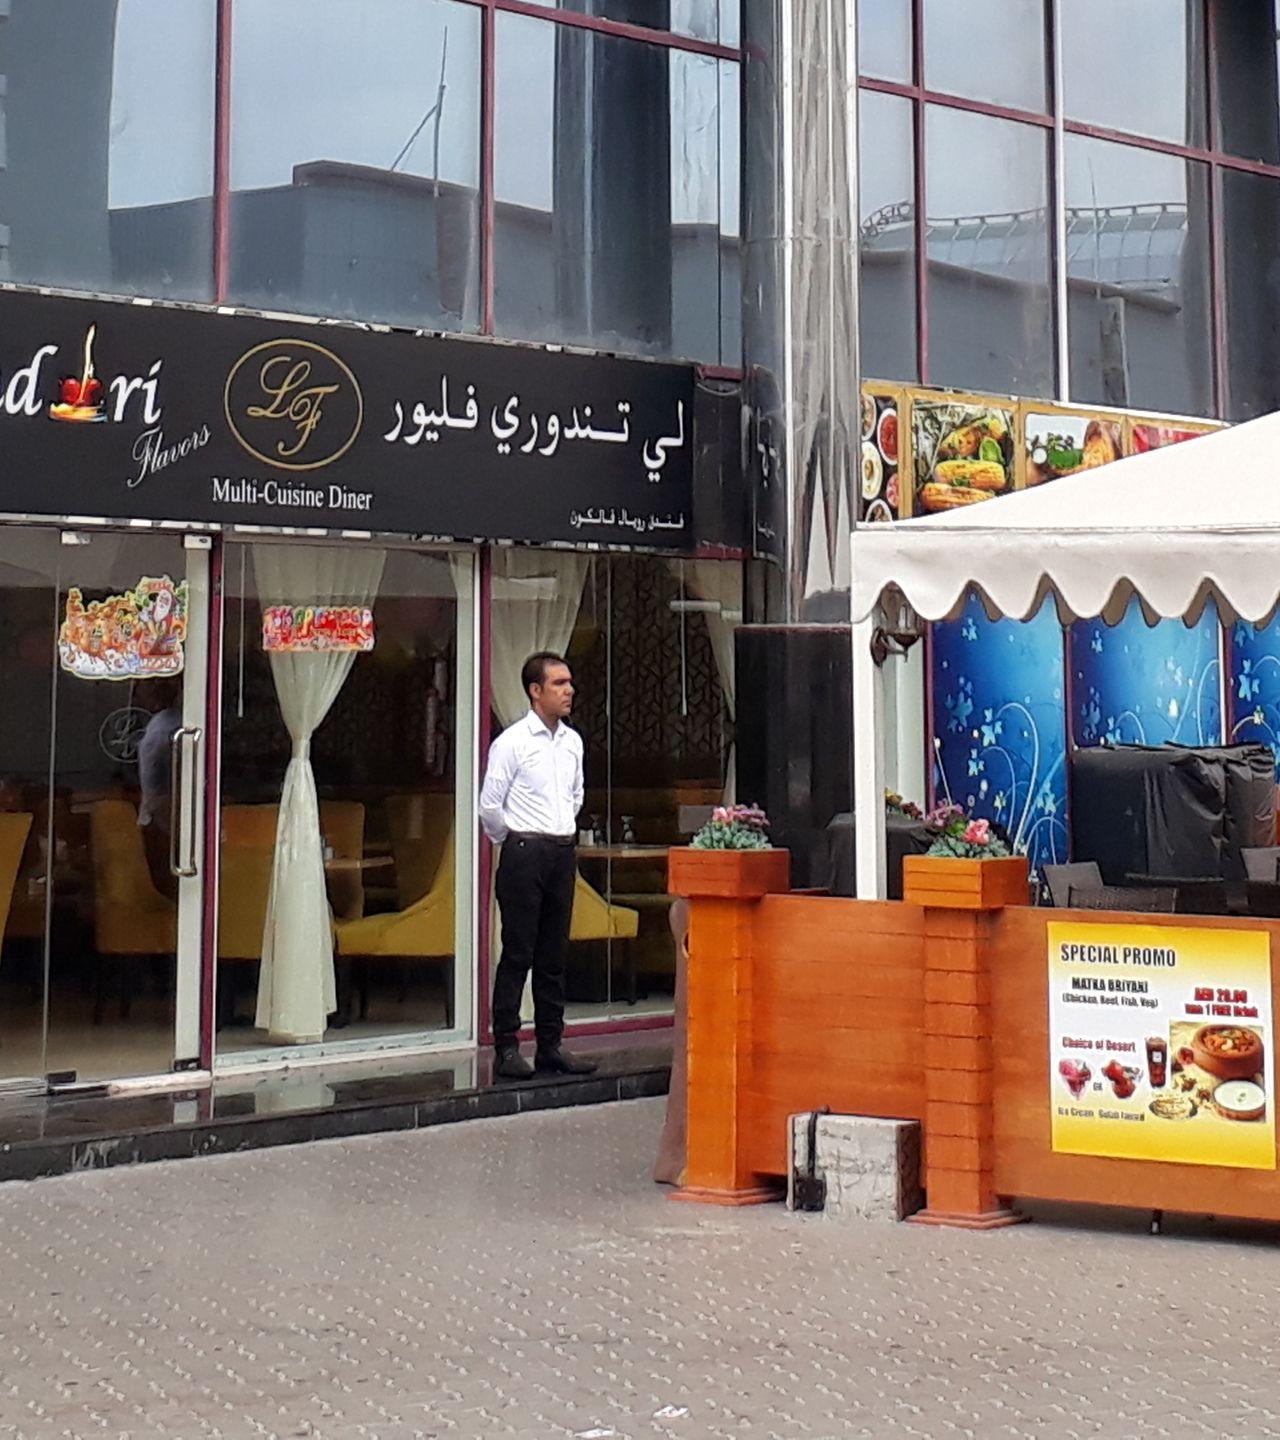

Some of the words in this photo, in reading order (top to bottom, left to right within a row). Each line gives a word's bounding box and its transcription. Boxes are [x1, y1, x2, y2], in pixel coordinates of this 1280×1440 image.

[383, 375, 478, 445] فليور
[490, 393, 631, 456] تندوري
[643, 400, 685, 482] لي
[127, 424, 211, 488] Flavors
[212, 478, 324, 507] Multi-Cuisine
[328, 485, 373, 510] Diner
[1061, 943, 1119, 964] SPECIAL
[1123, 947, 1176, 967] PROMO
